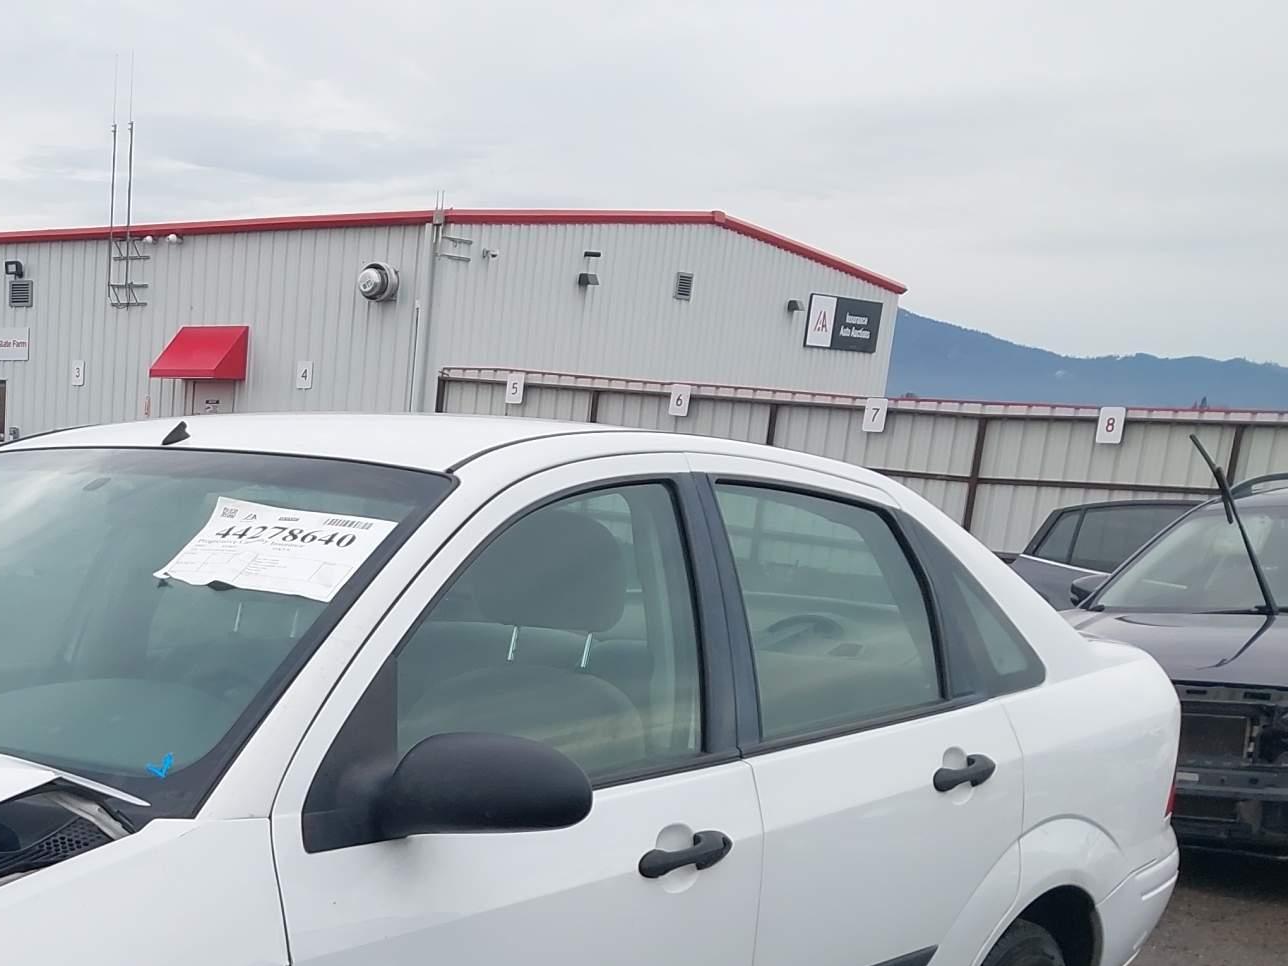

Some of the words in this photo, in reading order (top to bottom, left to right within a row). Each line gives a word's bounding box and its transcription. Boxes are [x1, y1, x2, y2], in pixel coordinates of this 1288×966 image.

[839, 325, 851, 337] Auto
[12, 340, 27, 348] Farm
[75, 367, 81, 378] 3
[301, 368, 308, 381] 4
[511, 382, 518, 395] 5
[675, 393, 683, 406] 6
[871, 407, 880, 422] 7
[1105, 417, 1115, 433] 8
[215, 525, 357, 548] 44278640
